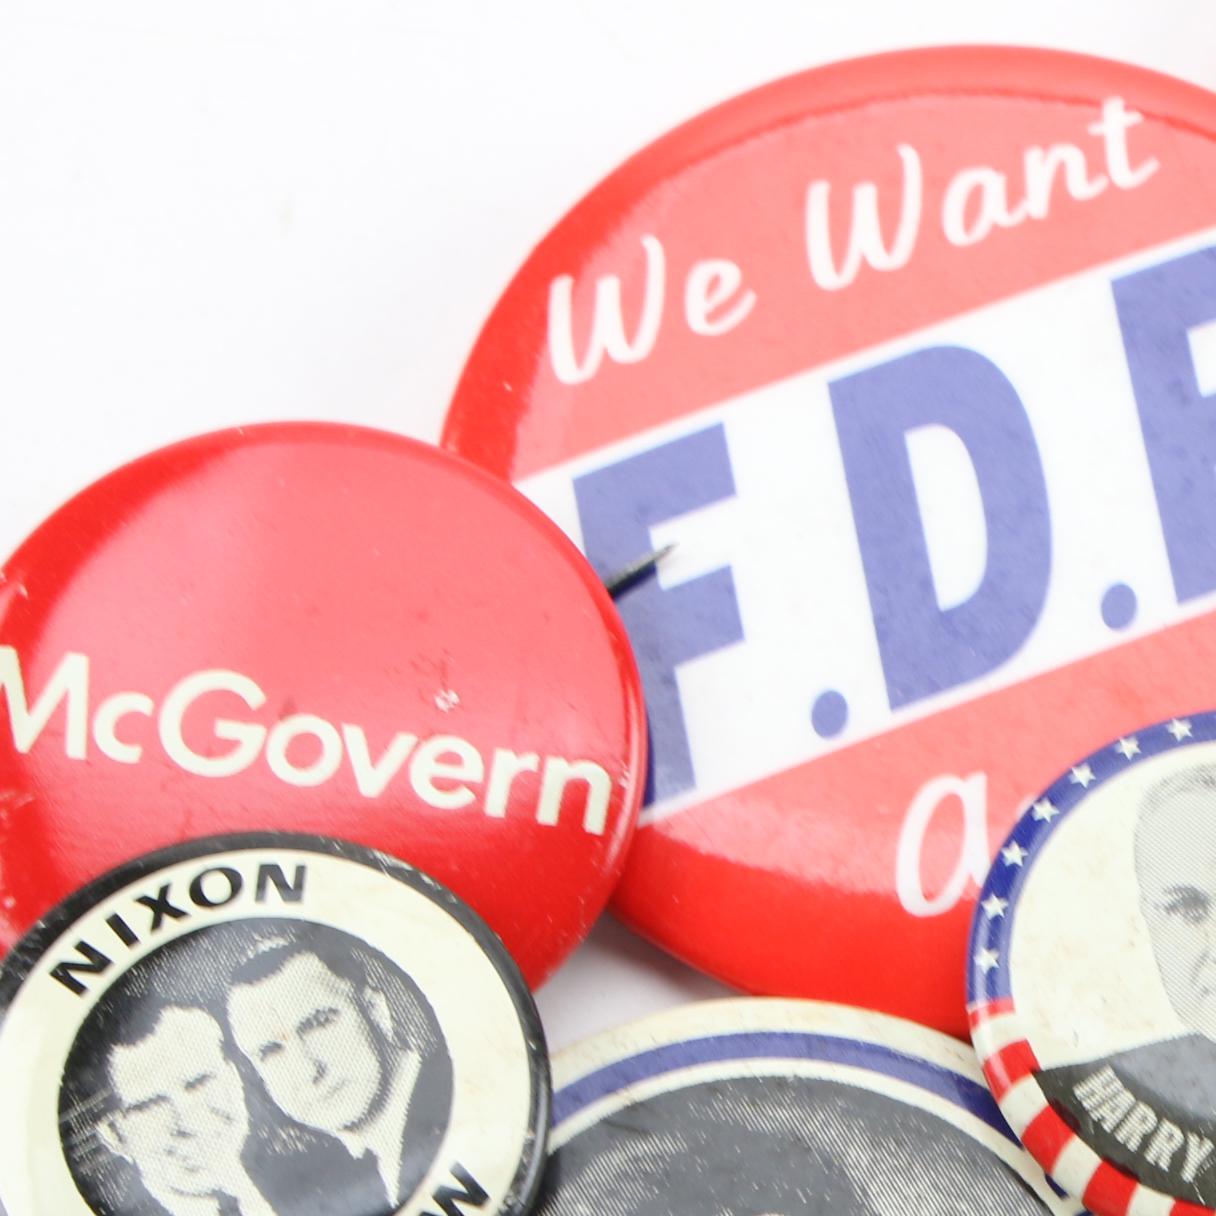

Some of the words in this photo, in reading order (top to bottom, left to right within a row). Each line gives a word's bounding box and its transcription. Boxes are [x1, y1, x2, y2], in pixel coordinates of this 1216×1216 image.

[547, 234, 757, 385] We
[804, 96, 1159, 291] Want
[0, 644, 611, 836] McGovern
[48, 861, 312, 998] NIXON
[1071, 1062, 1216, 1184] HARRY
